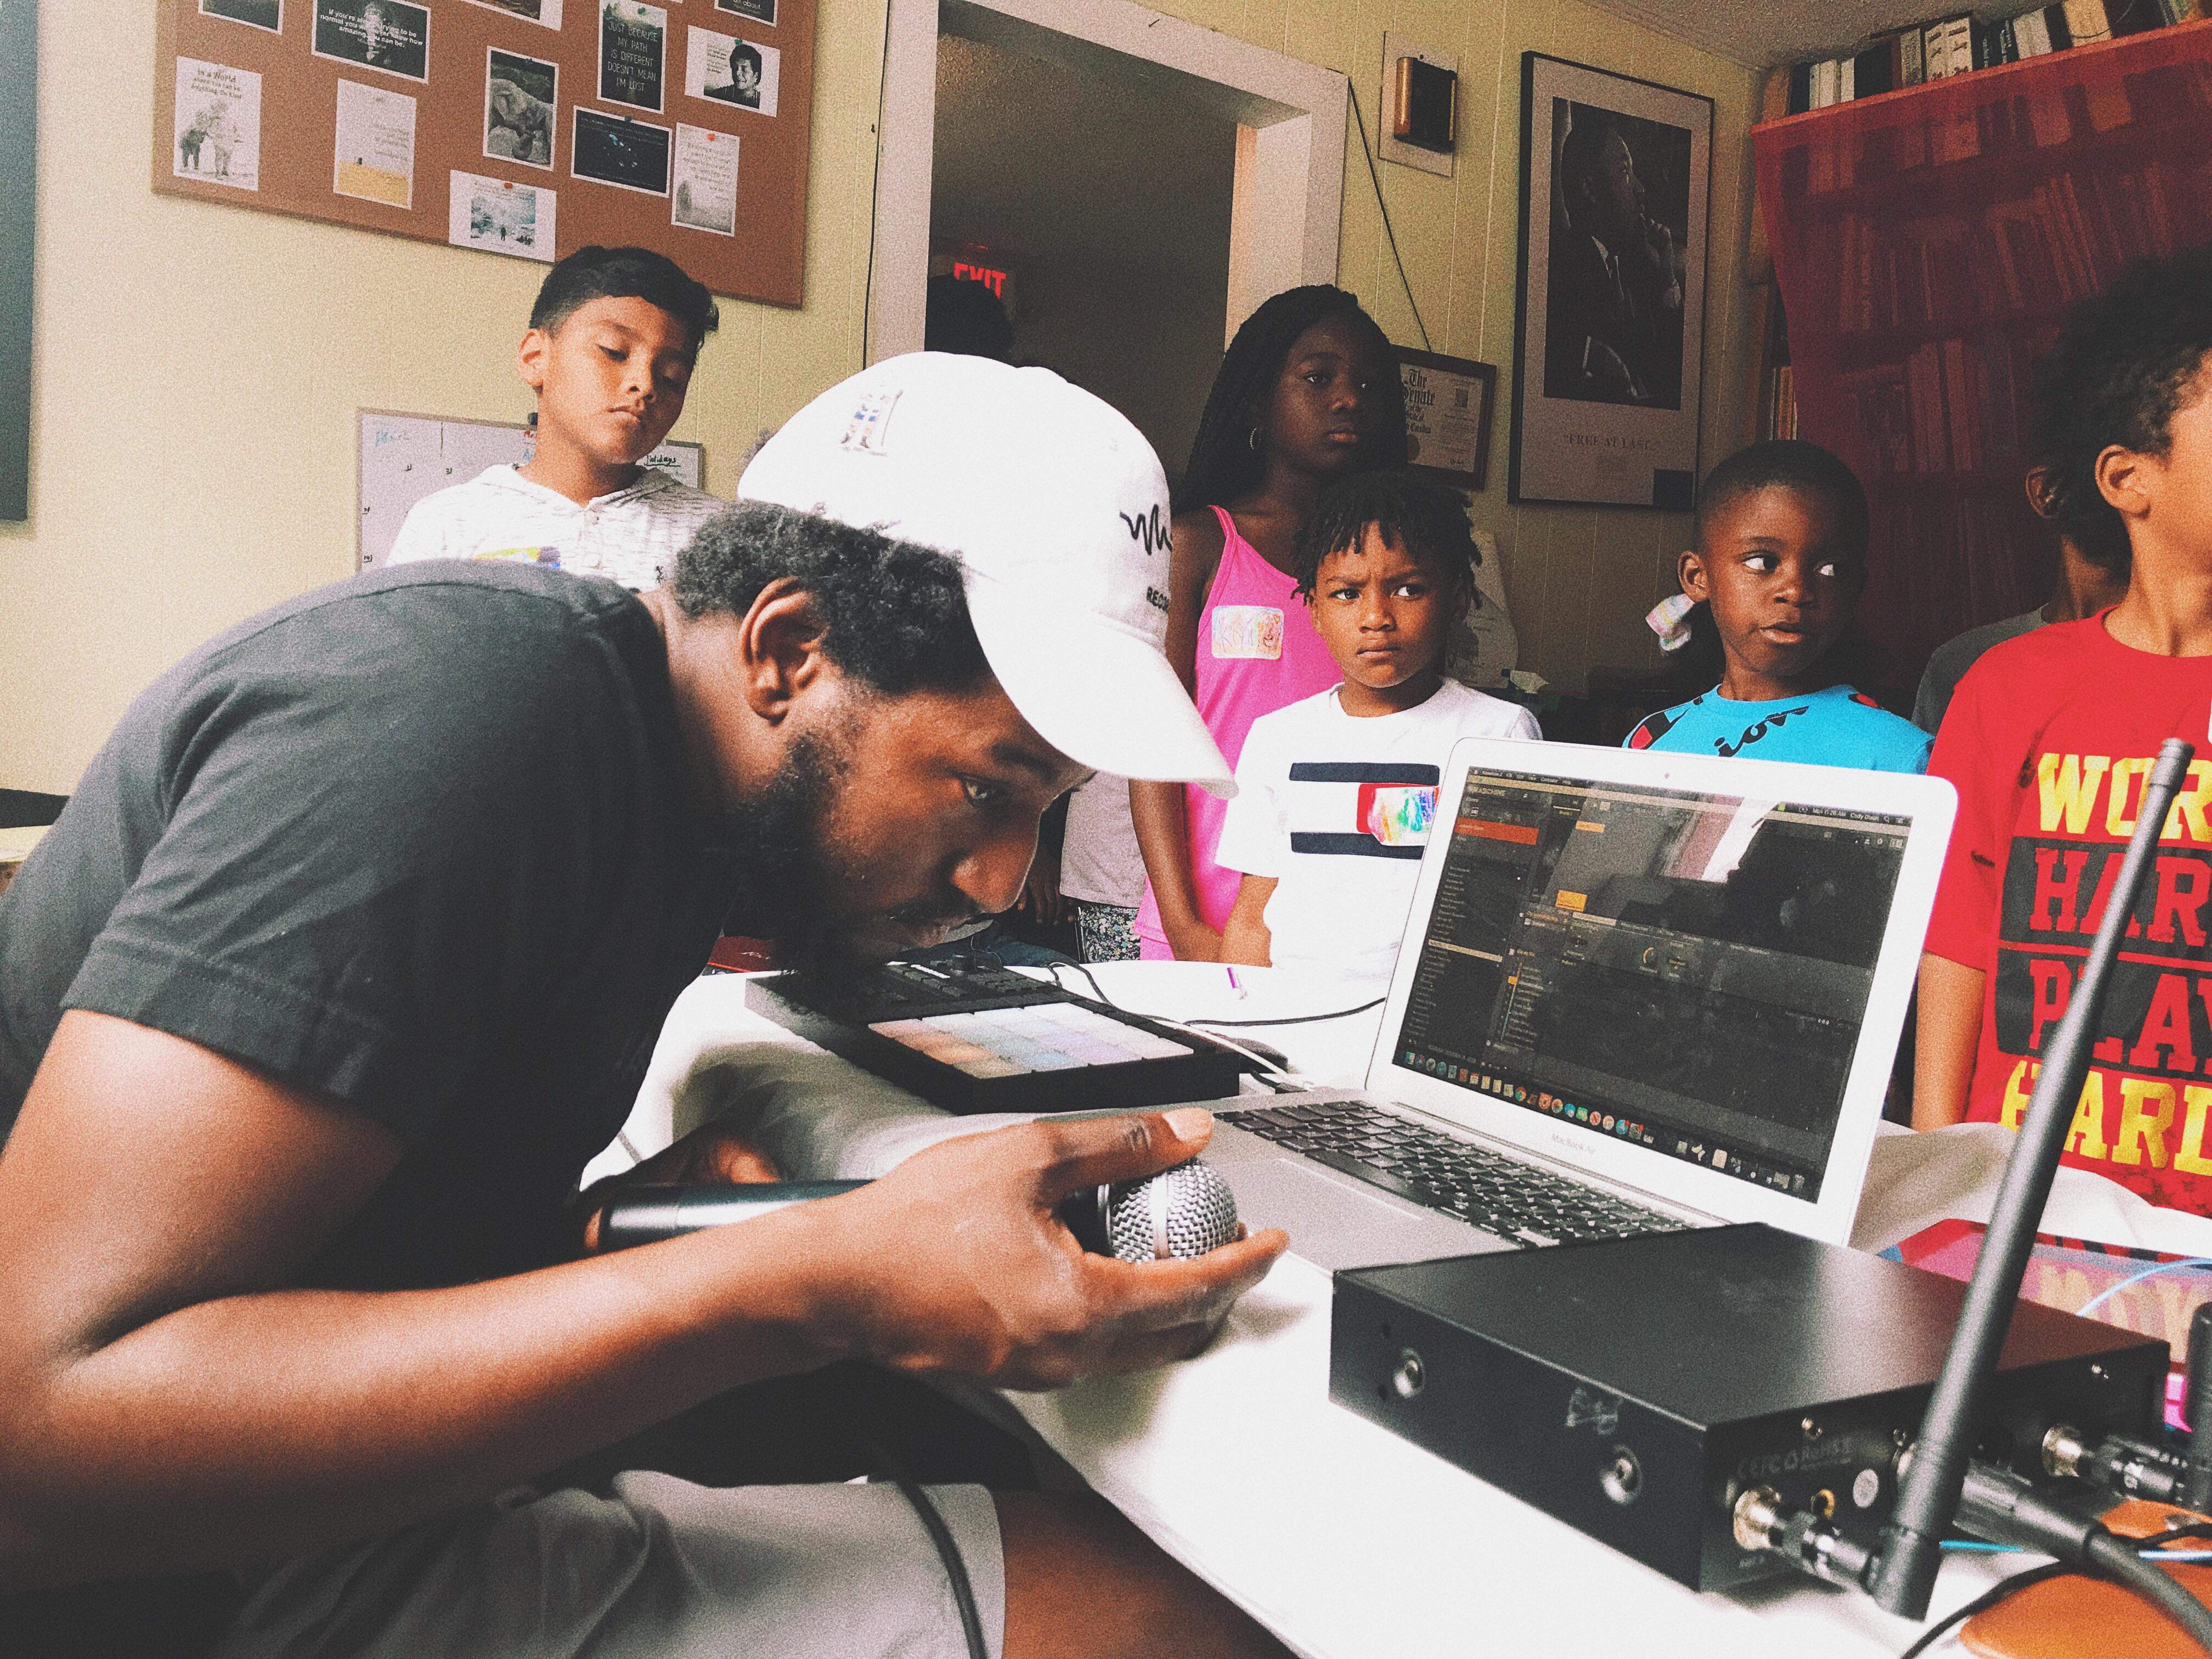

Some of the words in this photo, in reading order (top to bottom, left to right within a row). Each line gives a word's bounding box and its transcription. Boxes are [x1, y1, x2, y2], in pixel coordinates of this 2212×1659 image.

[743, 1, 761, 9] about
[320, 14, 344, 25] normal
[409, 37, 423, 46] how
[409, 30, 417, 38] be
[608, 21, 624, 32] JUST
[628, 26, 658, 42] BECAUSE
[618, 37, 627, 47] MY
[631, 40, 647, 52] PATH
[611, 49, 618, 58] IS
[621, 52, 653, 66] DIFFERENT
[638, 69, 657, 81] MEAN
[629, 81, 645, 91] LOST
[1404, 369, 1427, 388] The
[1551, 1133, 1584, 1151] MacBook
